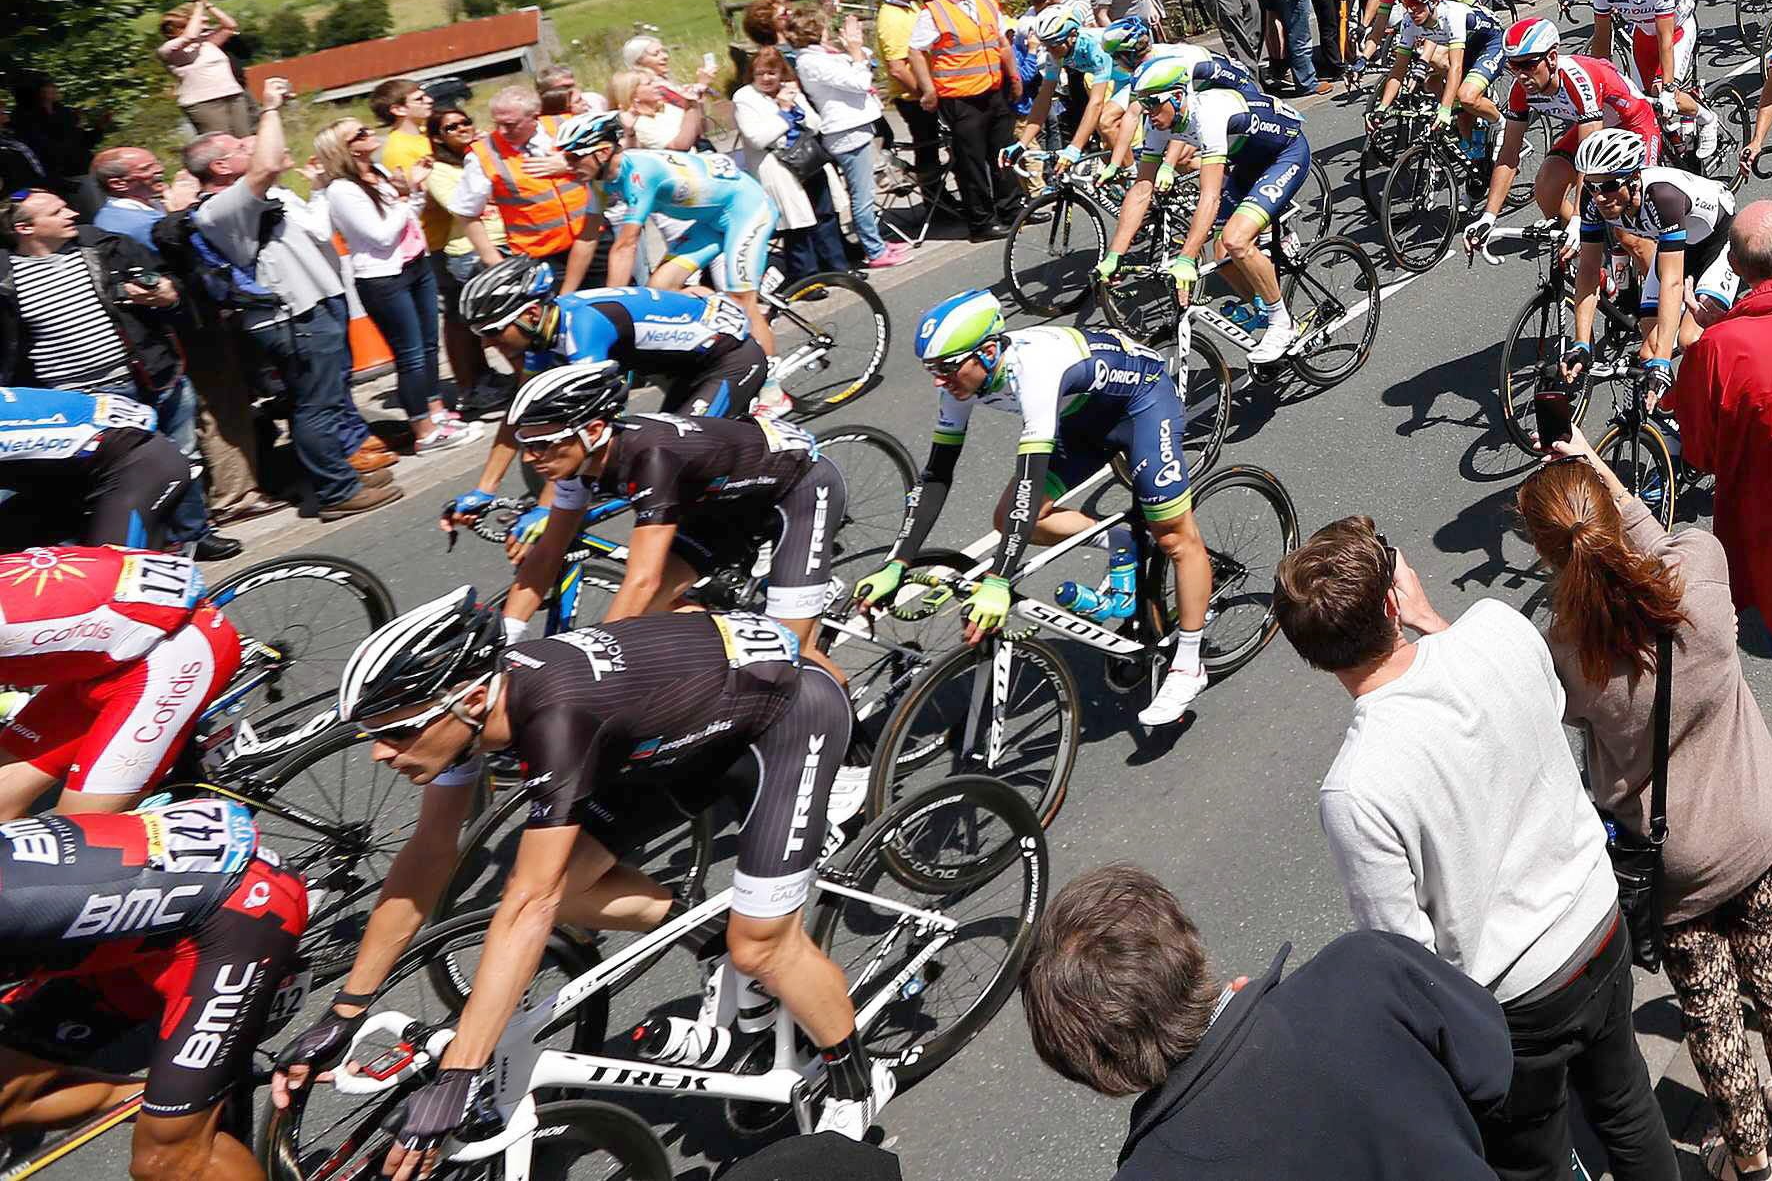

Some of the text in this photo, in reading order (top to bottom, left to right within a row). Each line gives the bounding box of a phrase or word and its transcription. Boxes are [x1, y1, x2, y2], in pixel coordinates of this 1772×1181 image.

[1571, 67, 1593, 102] ITERA
[1259, 123, 1281, 135] ORICA
[1277, 164, 1300, 190] ORICA
[735, 221, 769, 283] ASTANA
[640, 329, 696, 344] NetApp
[1088, 342, 1121, 352] SCOTT
[1108, 370, 1141, 386] ORICA
[1160, 418, 1172, 462] ORICA
[1020, 478, 1033, 509] ORICA
[805, 485, 830, 576] TREK
[140, 558, 190, 600] 174
[31, 618, 116, 647] Cofidis
[1024, 605, 1122, 647] SCOTT
[134, 660, 203, 744] Cofidis
[781, 733, 827, 862] TREK
[163, 806, 227, 864] 142
[1024, 855, 1041, 924] BONTRAGER
[61, 884, 204, 940] BMC
[172, 961, 259, 1070] BMC
[269, 985, 304, 1019] 42
[588, 1066, 712, 1092] TREK
